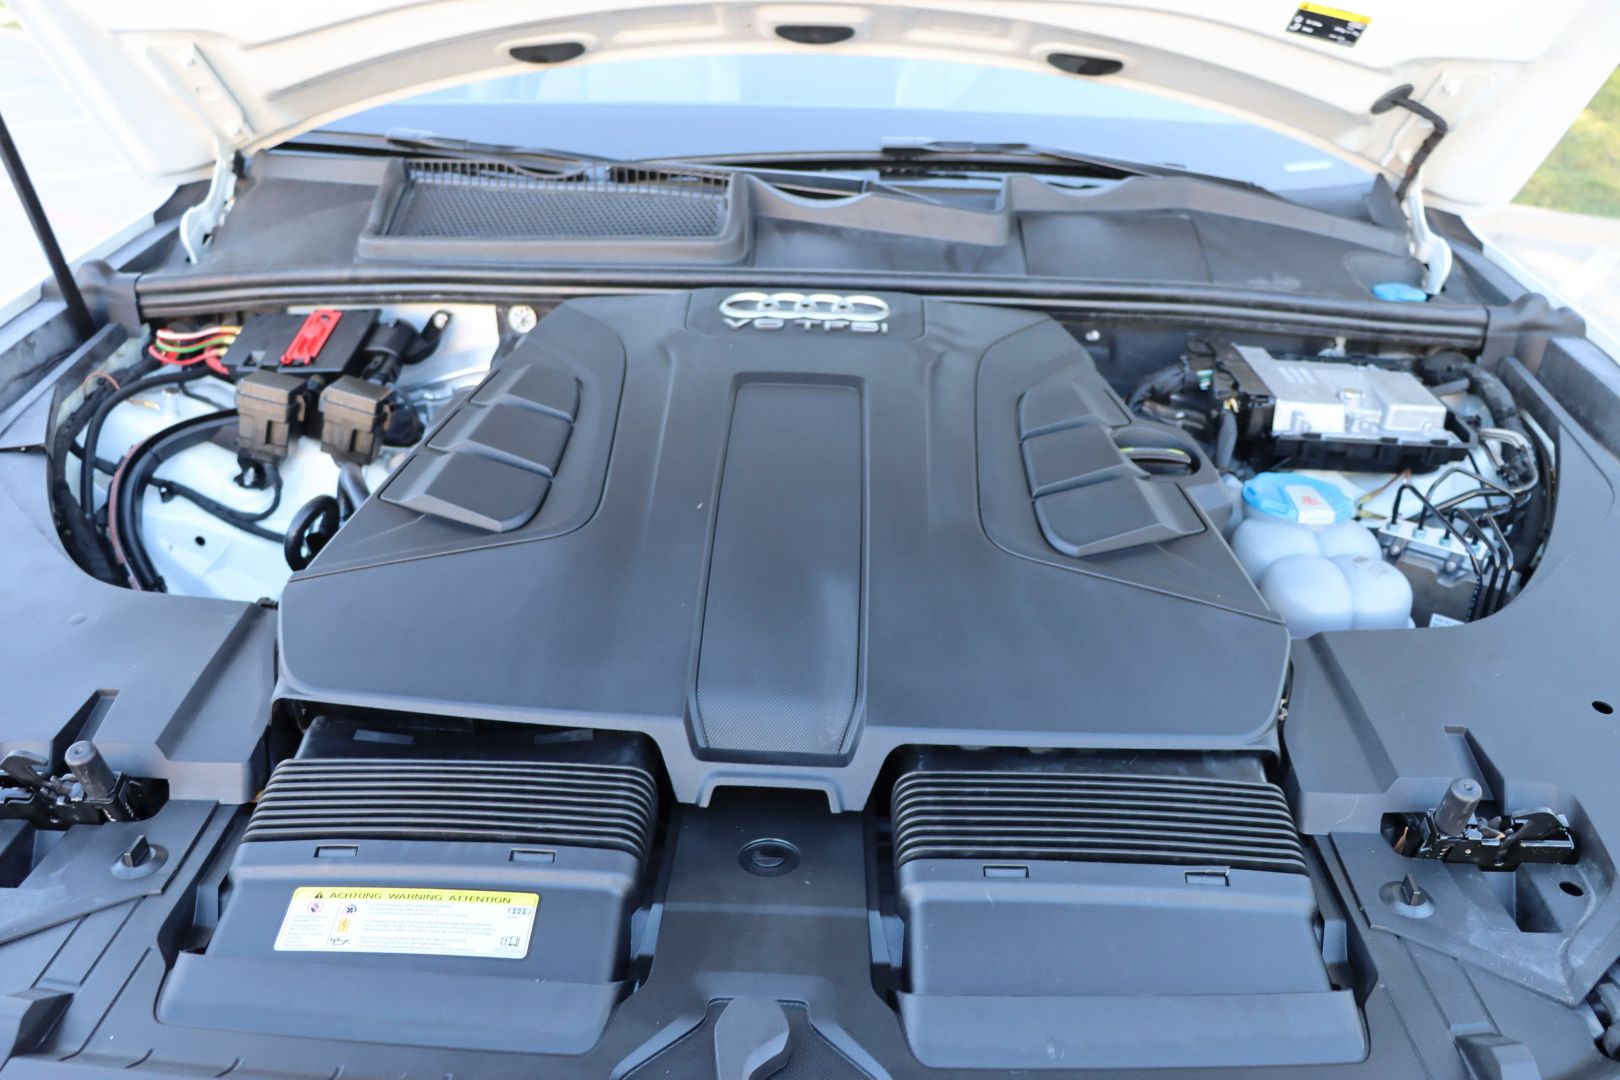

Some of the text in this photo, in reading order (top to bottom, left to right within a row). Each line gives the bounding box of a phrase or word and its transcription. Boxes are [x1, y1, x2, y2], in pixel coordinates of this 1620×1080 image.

[330, 892, 512, 904] ACHTUNG WARNING ATTENTION
